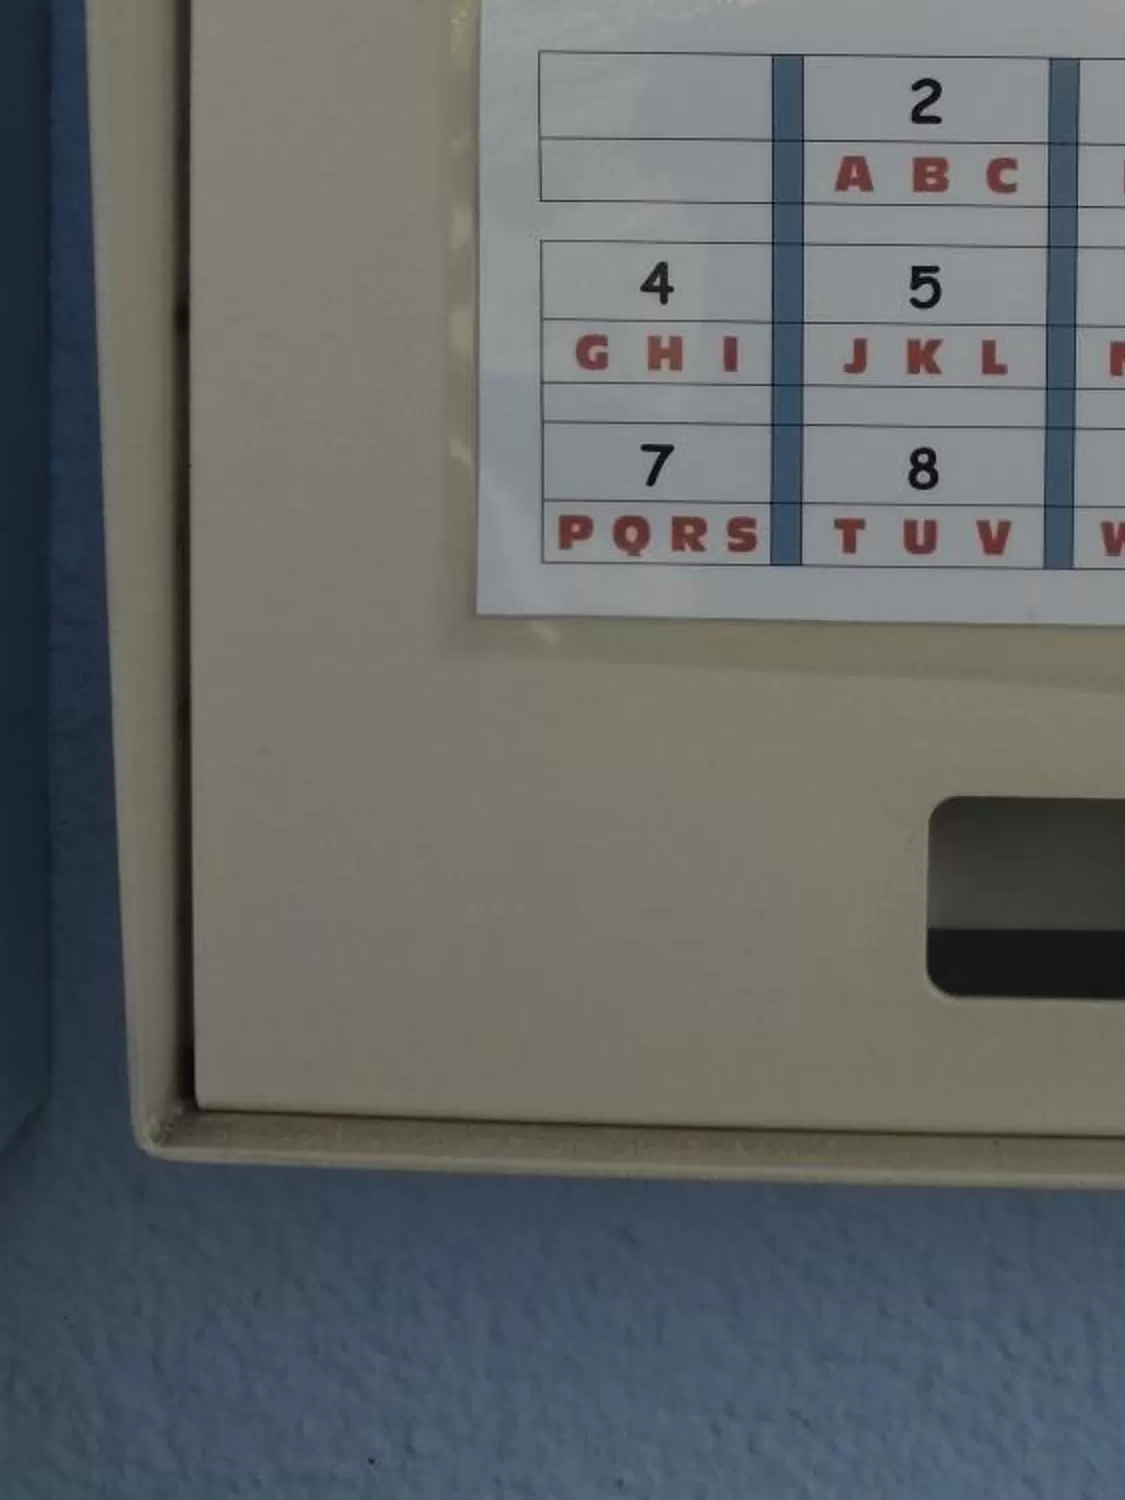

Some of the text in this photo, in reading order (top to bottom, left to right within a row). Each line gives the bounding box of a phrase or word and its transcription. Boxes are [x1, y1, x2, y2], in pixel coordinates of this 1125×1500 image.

[910, 78, 943, 125] 2
[640, 262, 674, 305] 4
[908, 265, 942, 309] 5
[640, 444, 676, 487] 7
[908, 447, 939, 490] 8
